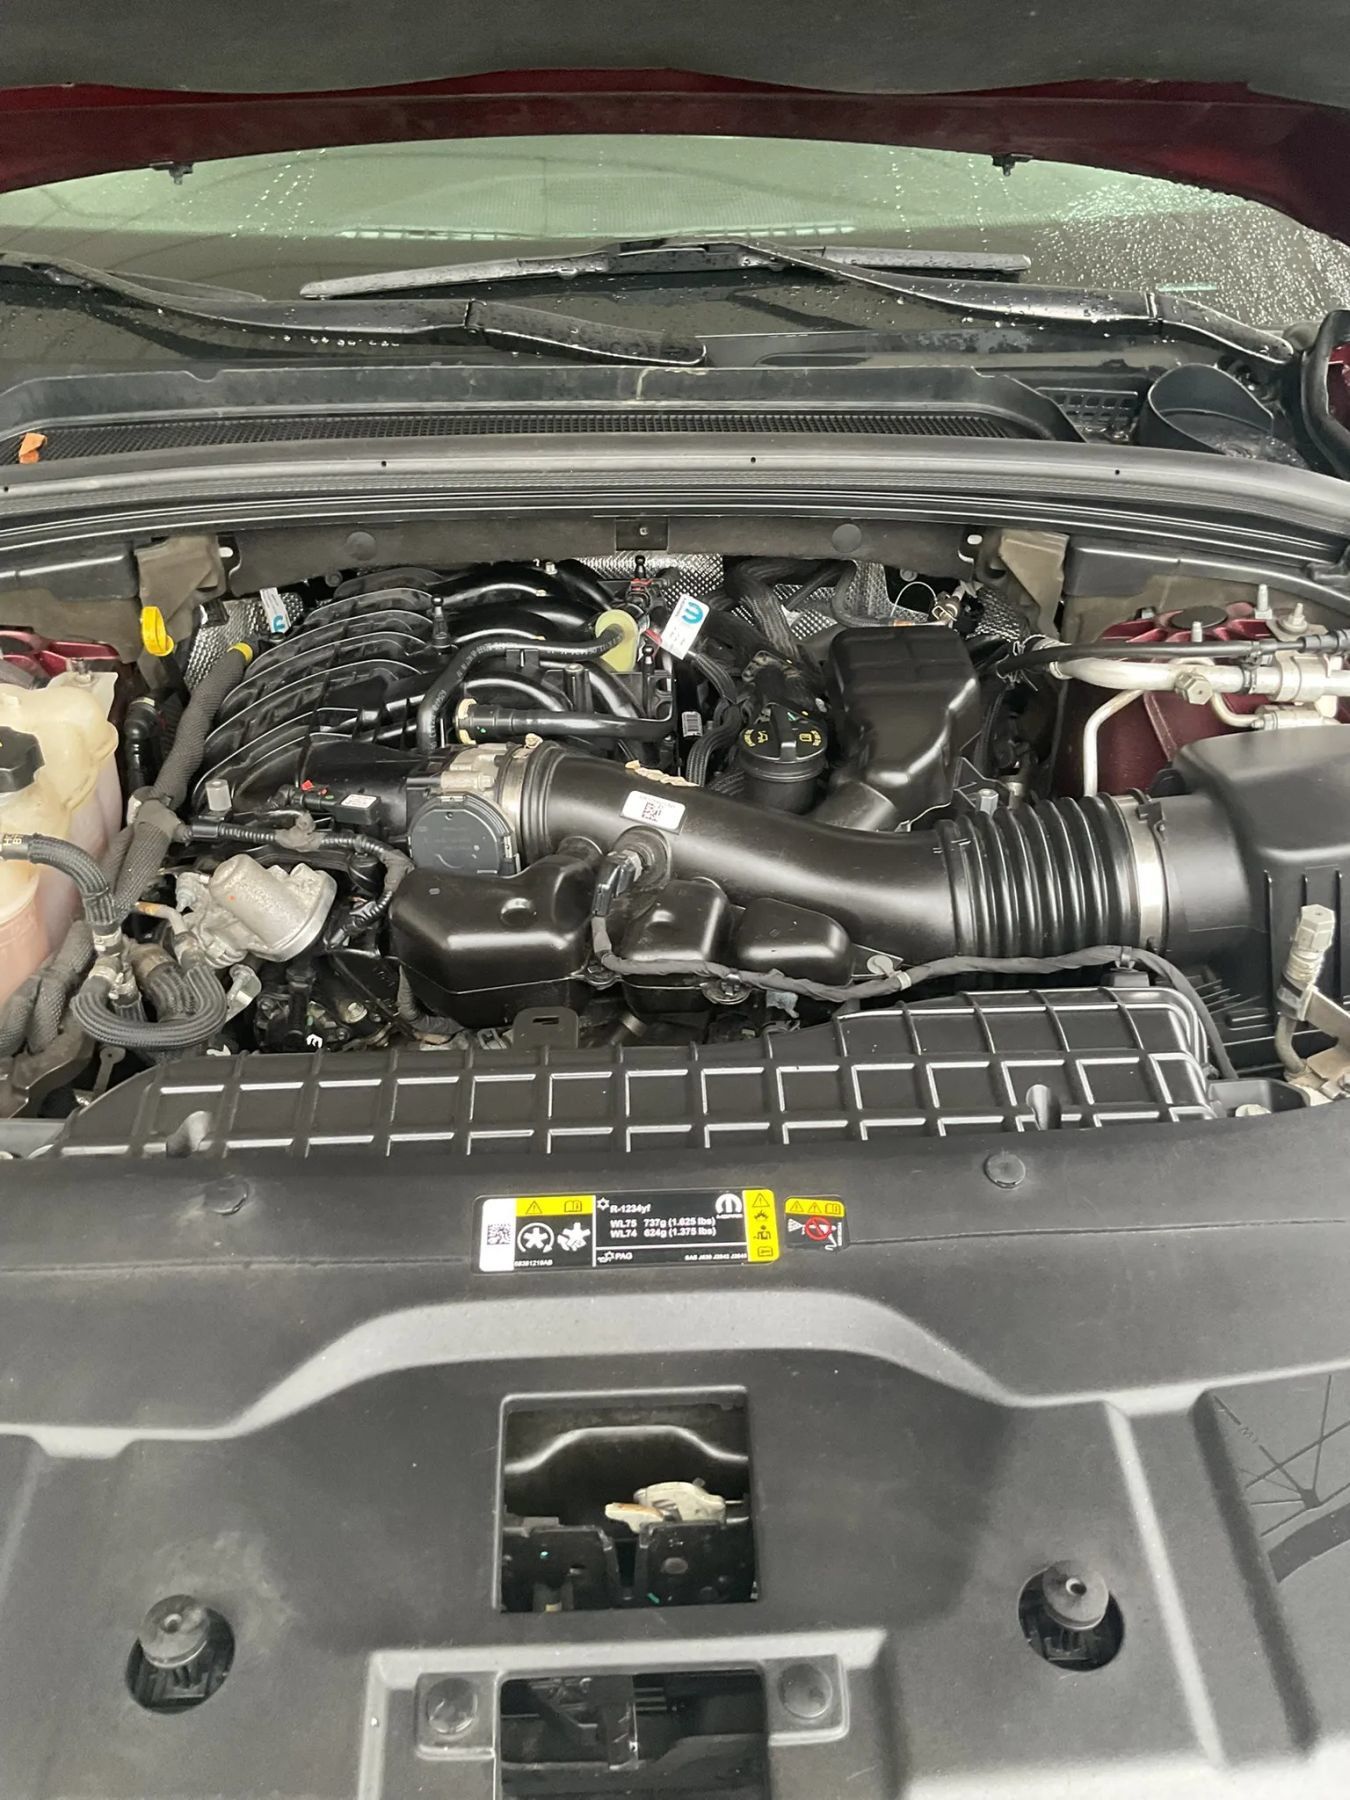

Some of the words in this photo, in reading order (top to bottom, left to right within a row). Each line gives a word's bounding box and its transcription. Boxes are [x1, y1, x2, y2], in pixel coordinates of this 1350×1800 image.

[609, 1203, 651, 1215] R-1234yf
[610, 1219, 637, 1228] WL75
[643, 1218, 667, 1229] 737g
[698, 1216, 716, 1227] lbs)
[610, 1229, 637, 1239] WL74
[643, 1228, 667, 1239] 624g
[668, 1227, 697, 1238] (1.375
[698, 1226, 717, 1237] lbs)
[615, 1252, 633, 1260] PAG
